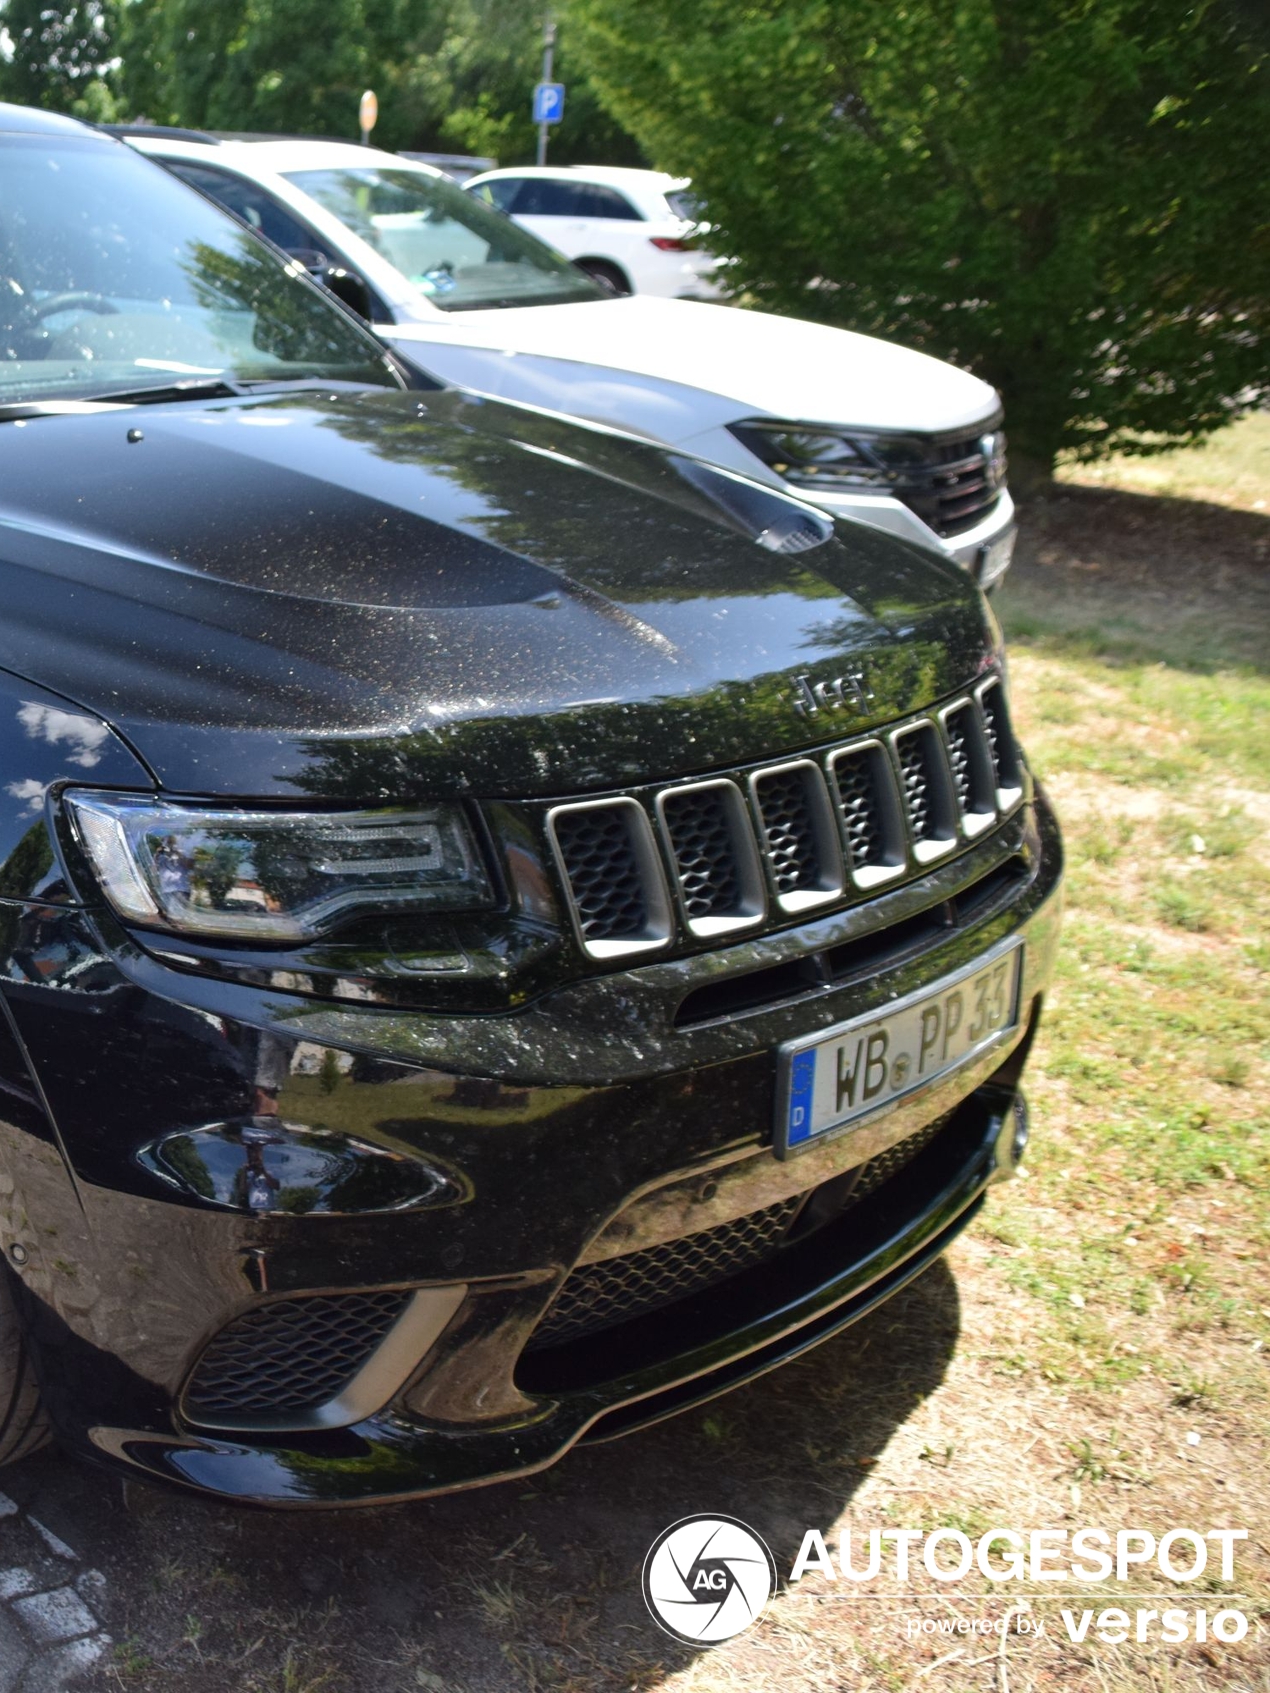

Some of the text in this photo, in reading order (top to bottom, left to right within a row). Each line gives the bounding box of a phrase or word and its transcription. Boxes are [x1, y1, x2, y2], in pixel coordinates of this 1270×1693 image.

[540, 88, 558, 117] P
[835, 960, 1009, 1114] WB PP 33
[791, 1106, 805, 1128] D
